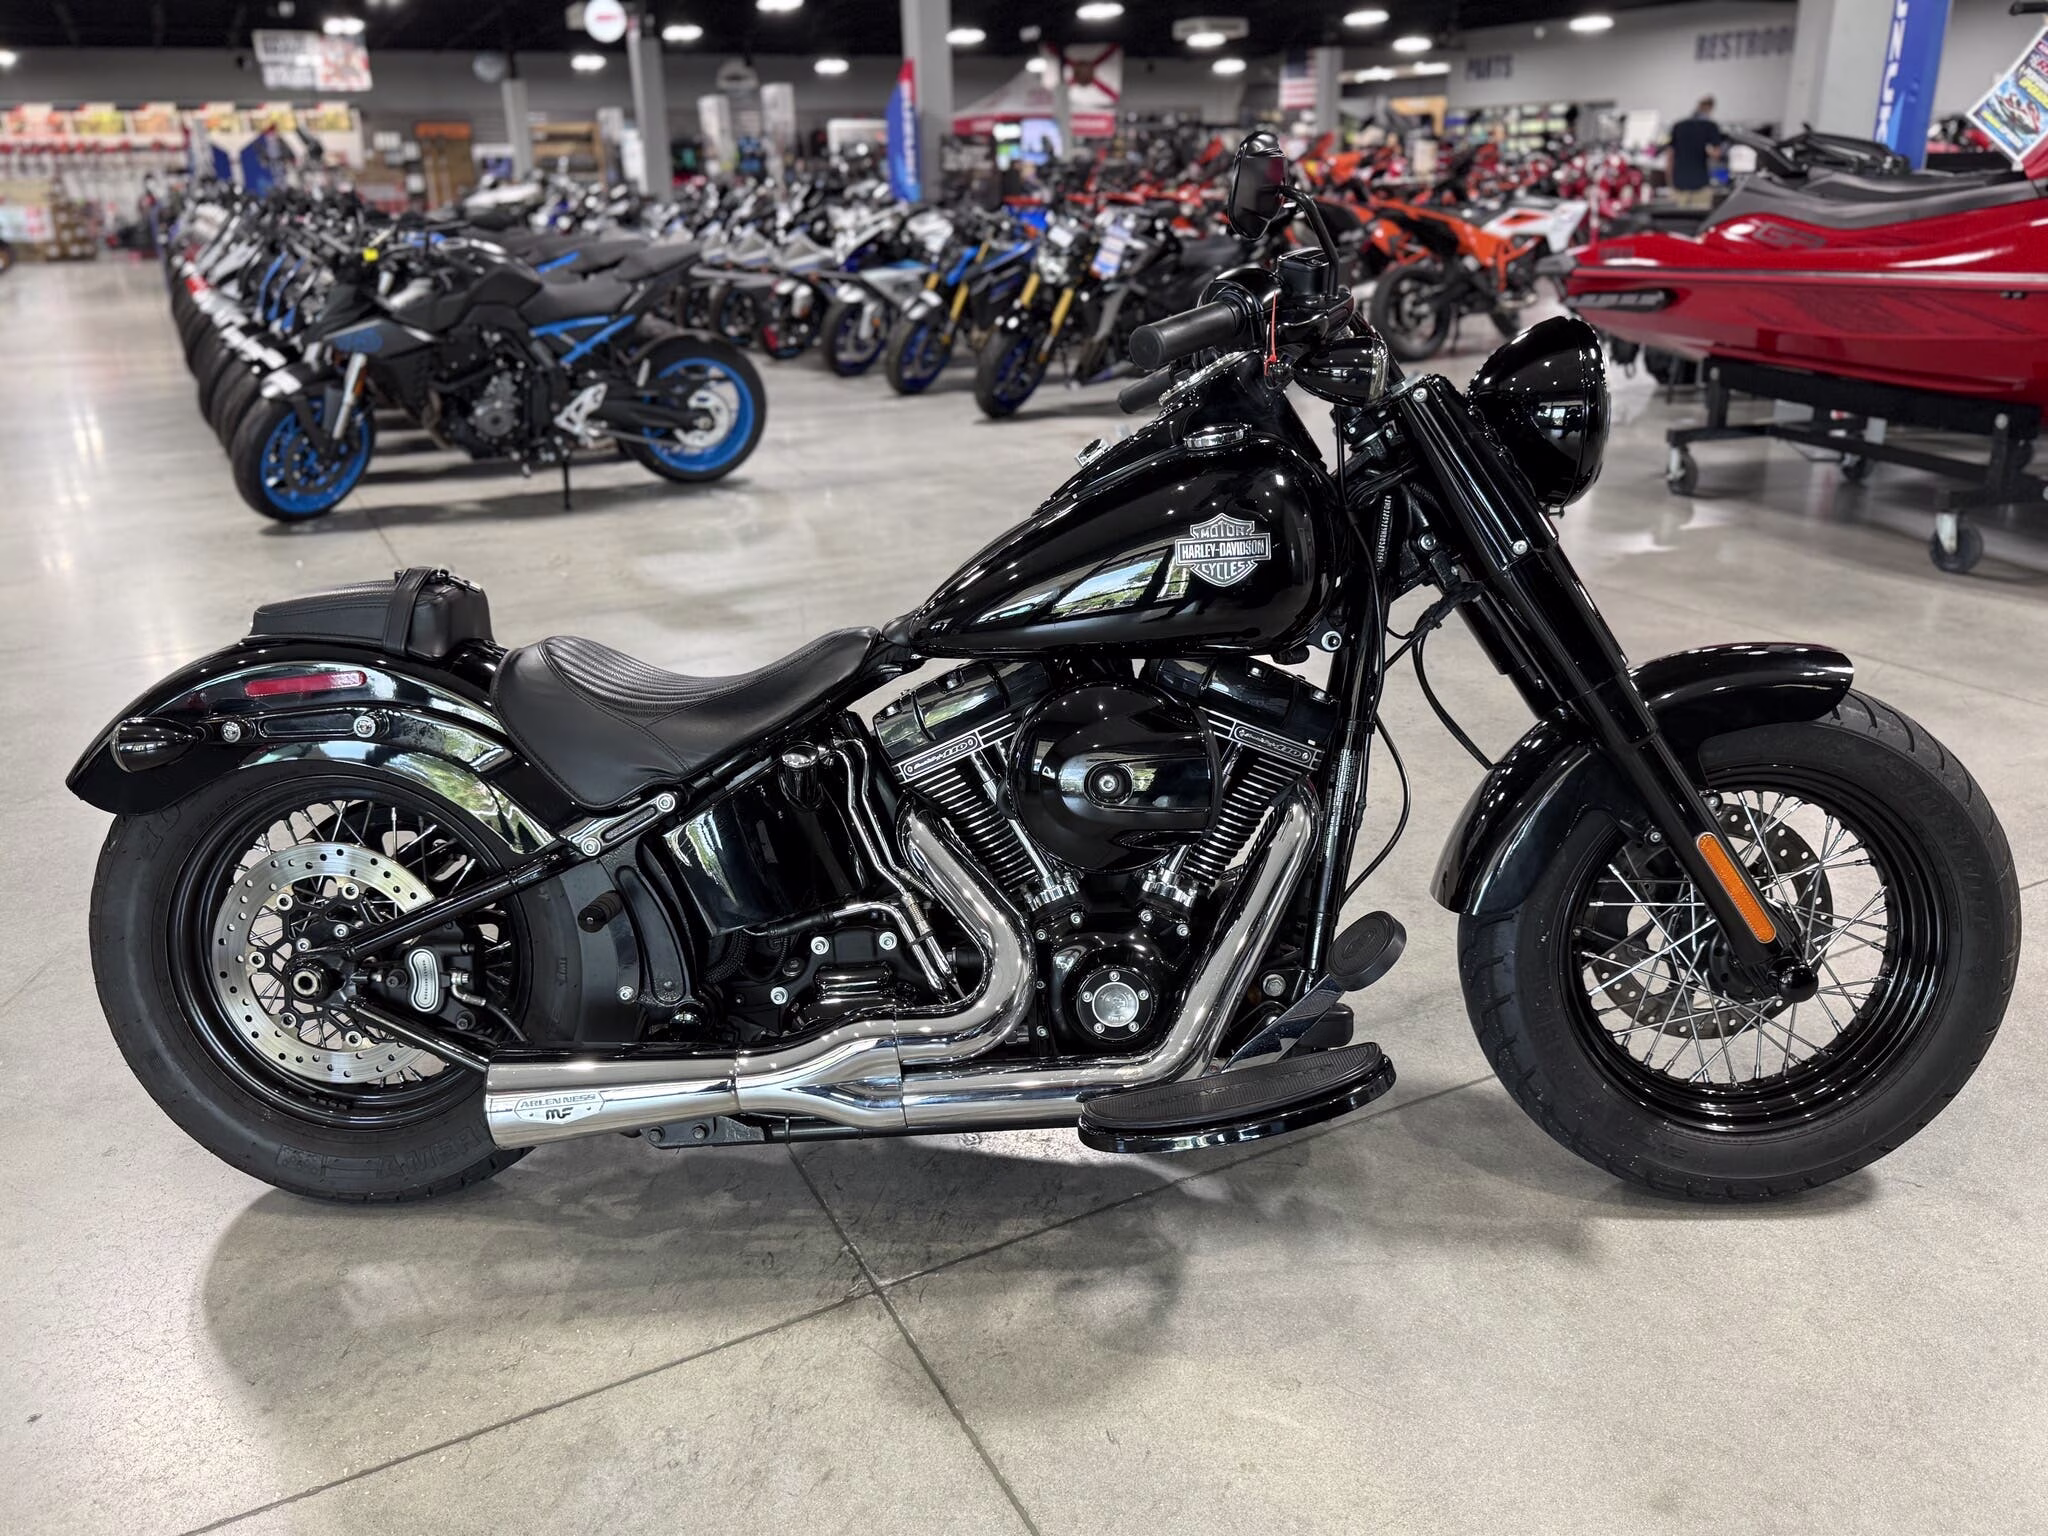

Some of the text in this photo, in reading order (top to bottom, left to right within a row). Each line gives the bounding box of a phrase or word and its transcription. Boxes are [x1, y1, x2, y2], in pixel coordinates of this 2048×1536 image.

[1695, 25, 1796, 62] RESTROO
[1199, 519, 1246, 539] MOTOR
[1181, 538, 1265, 560] HARLEY-DAVIDSON
[1201, 560, 1247, 580] CYCLES
[520, 1092, 597, 1108] ARLEN NESS
